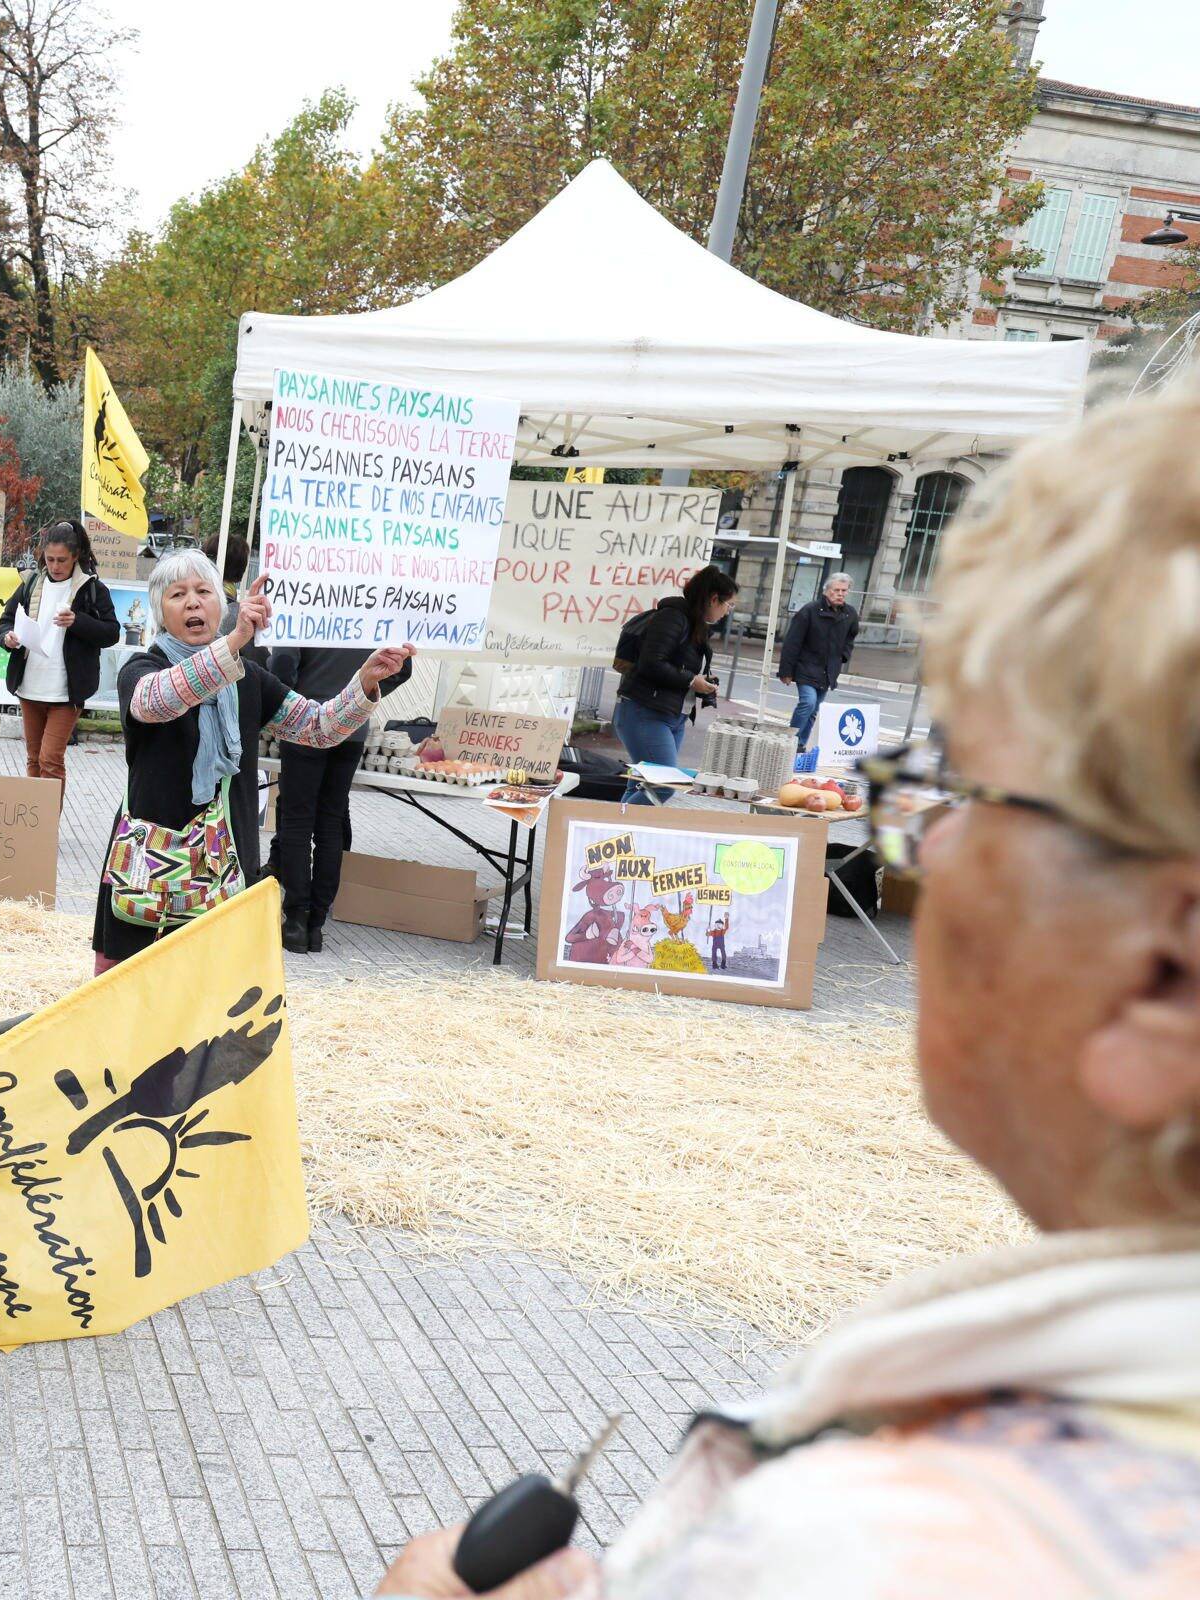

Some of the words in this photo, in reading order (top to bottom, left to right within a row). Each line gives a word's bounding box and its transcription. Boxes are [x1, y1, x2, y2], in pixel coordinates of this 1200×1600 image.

[388, 386, 474, 425] PAYSANS
[275, 406, 314, 432] NOUS
[429, 426, 449, 454] LA
[456, 429, 515, 460] TERRE
[391, 456, 475, 489] PAYSANS
[270, 474, 293, 500] LA
[300, 478, 363, 509] TERRE
[372, 485, 394, 512] DE
[400, 488, 425, 515] NOS
[432, 492, 504, 526] ENFANTS
[532, 488, 594, 520] UNE
[604, 489, 720, 526] AUTRE
[268, 508, 373, 543] PAYSANNES
[383, 519, 460, 550] PAYSANS
[264, 543, 302, 571] PLUS
[307, 546, 383, 576] QUESTION
[391, 555, 408, 577] DE
[493, 557, 572, 585] POUR
[383, 585, 457, 615] PAYSANS
[542, 591, 658, 625] PAYSA
[373, 619, 394, 642] ET
[465, 711, 507, 729] VENTE
[514, 719, 539, 730] DES
[458, 730, 522, 752] DERNIERS
[587, 835, 632, 864] NON
[617, 860, 651, 878] AUX
[653, 866, 703, 894] FERMES
[697, 889, 731, 902] USINES
